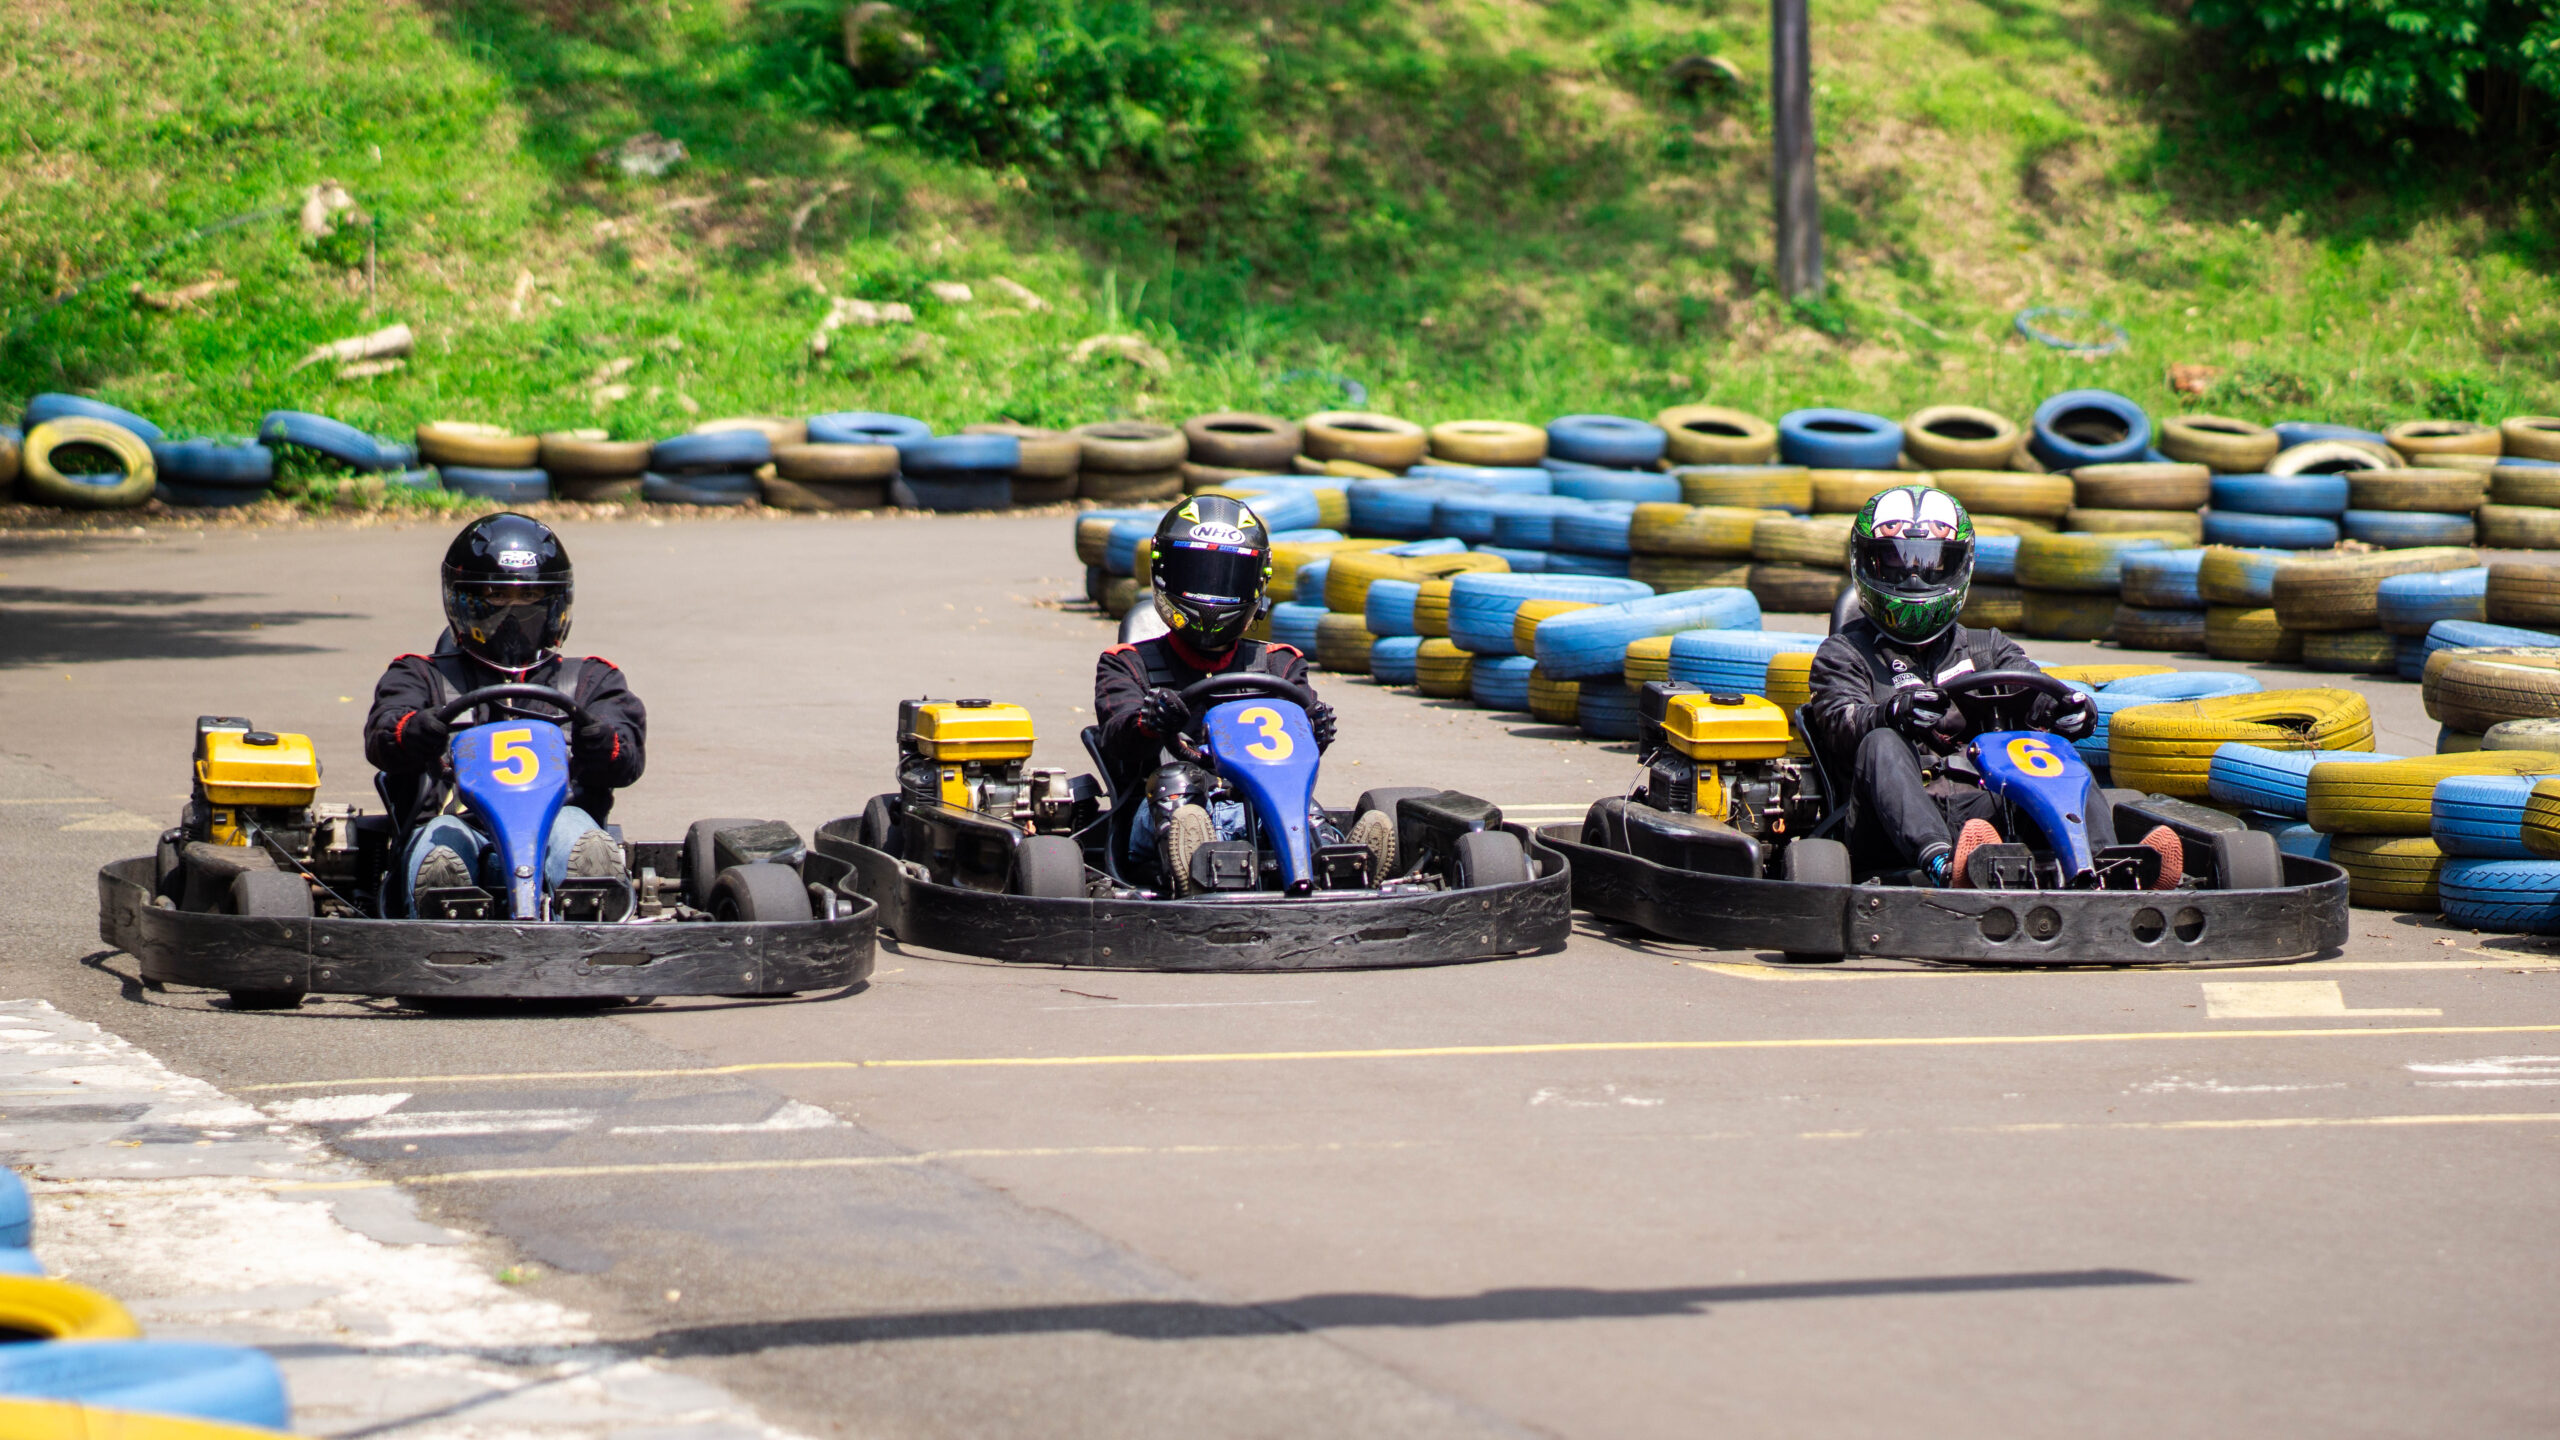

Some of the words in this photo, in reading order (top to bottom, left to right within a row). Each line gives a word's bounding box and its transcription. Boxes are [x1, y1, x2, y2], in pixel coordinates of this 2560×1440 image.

[1197, 526, 1237, 540] NHK
[491, 728, 540, 785] 5
[1237, 706, 1294, 761] 3
[2006, 738, 2064, 777] 6
